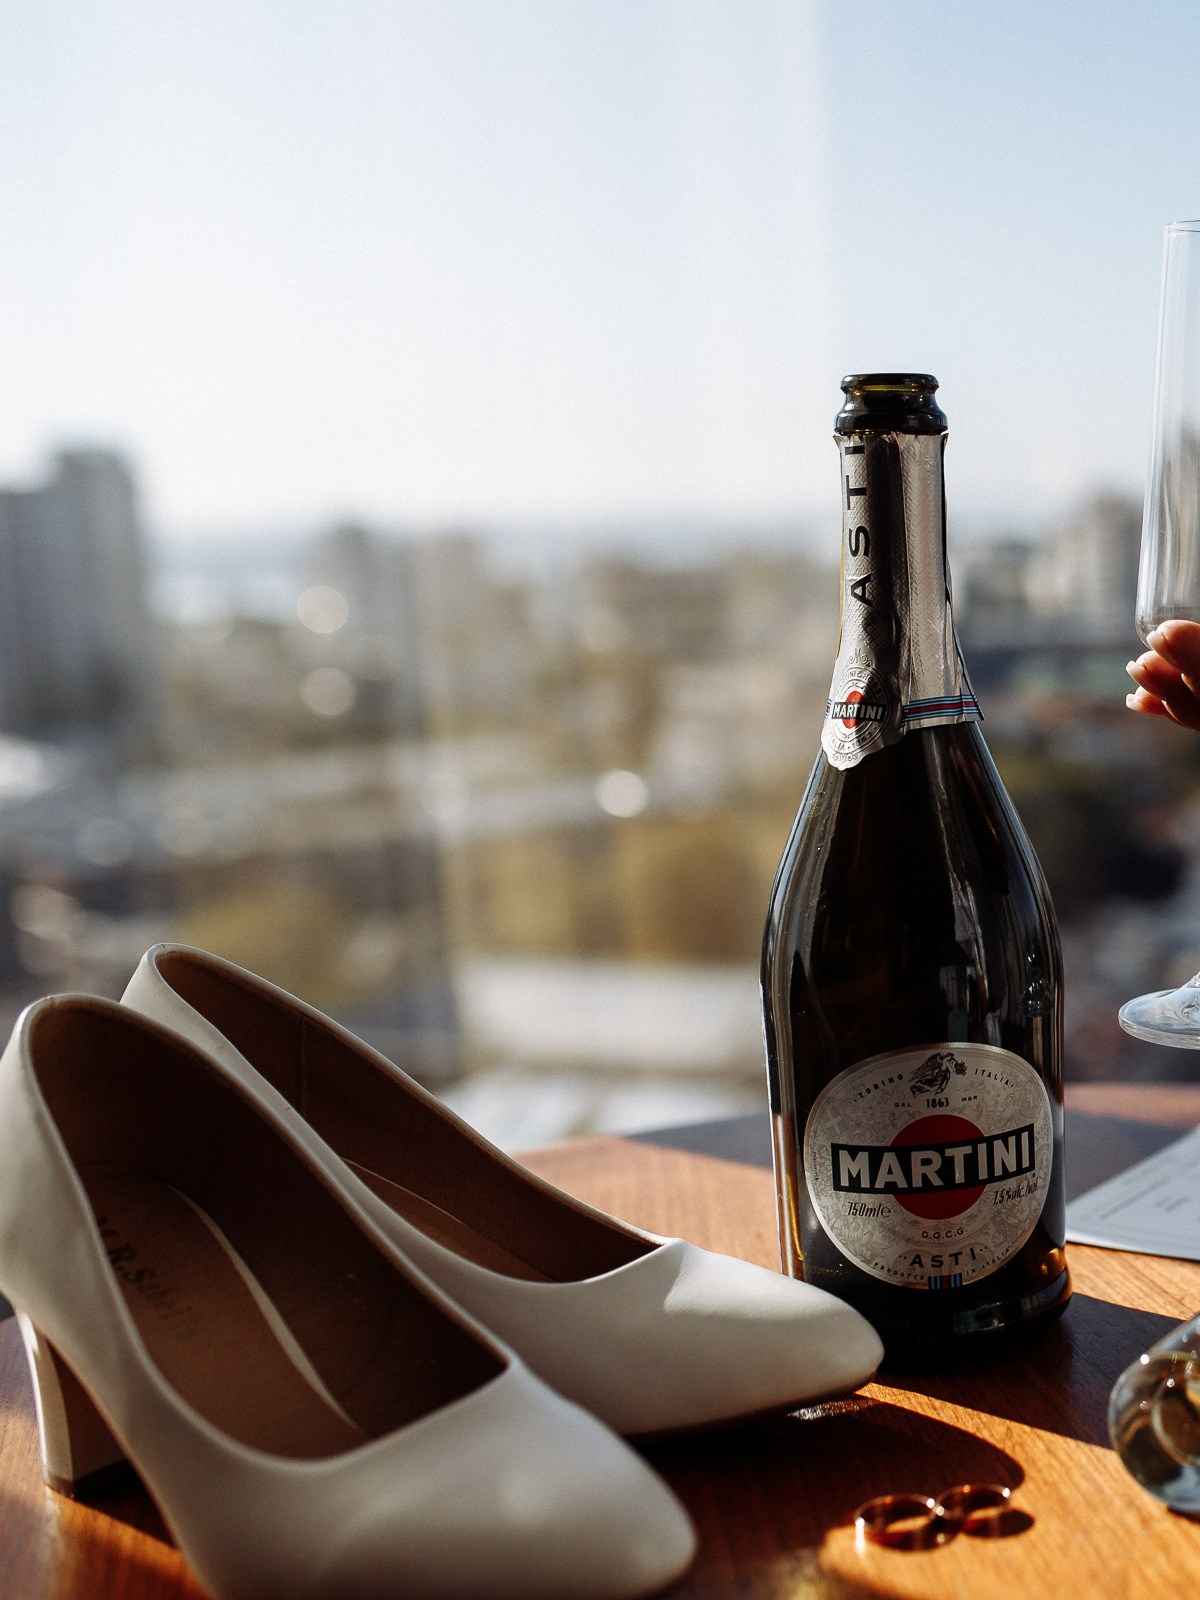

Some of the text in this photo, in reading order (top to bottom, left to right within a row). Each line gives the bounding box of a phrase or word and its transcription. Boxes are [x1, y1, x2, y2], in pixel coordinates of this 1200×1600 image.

[845, 444, 872, 608] ASTI
[833, 702, 883, 720] MARTINI
[858, 1068, 1010, 1099] TORINO ITALIA
[926, 1097, 950, 1109] 1863
[839, 1131, 1030, 1189] MARTINI
[921, 1227, 968, 1239] D.O.C.G.
[873, 1262, 925, 1280] PRODOTTO
[982, 1247, 1010, 1270] ITALIA
[909, 1247, 977, 1268] ASTI
